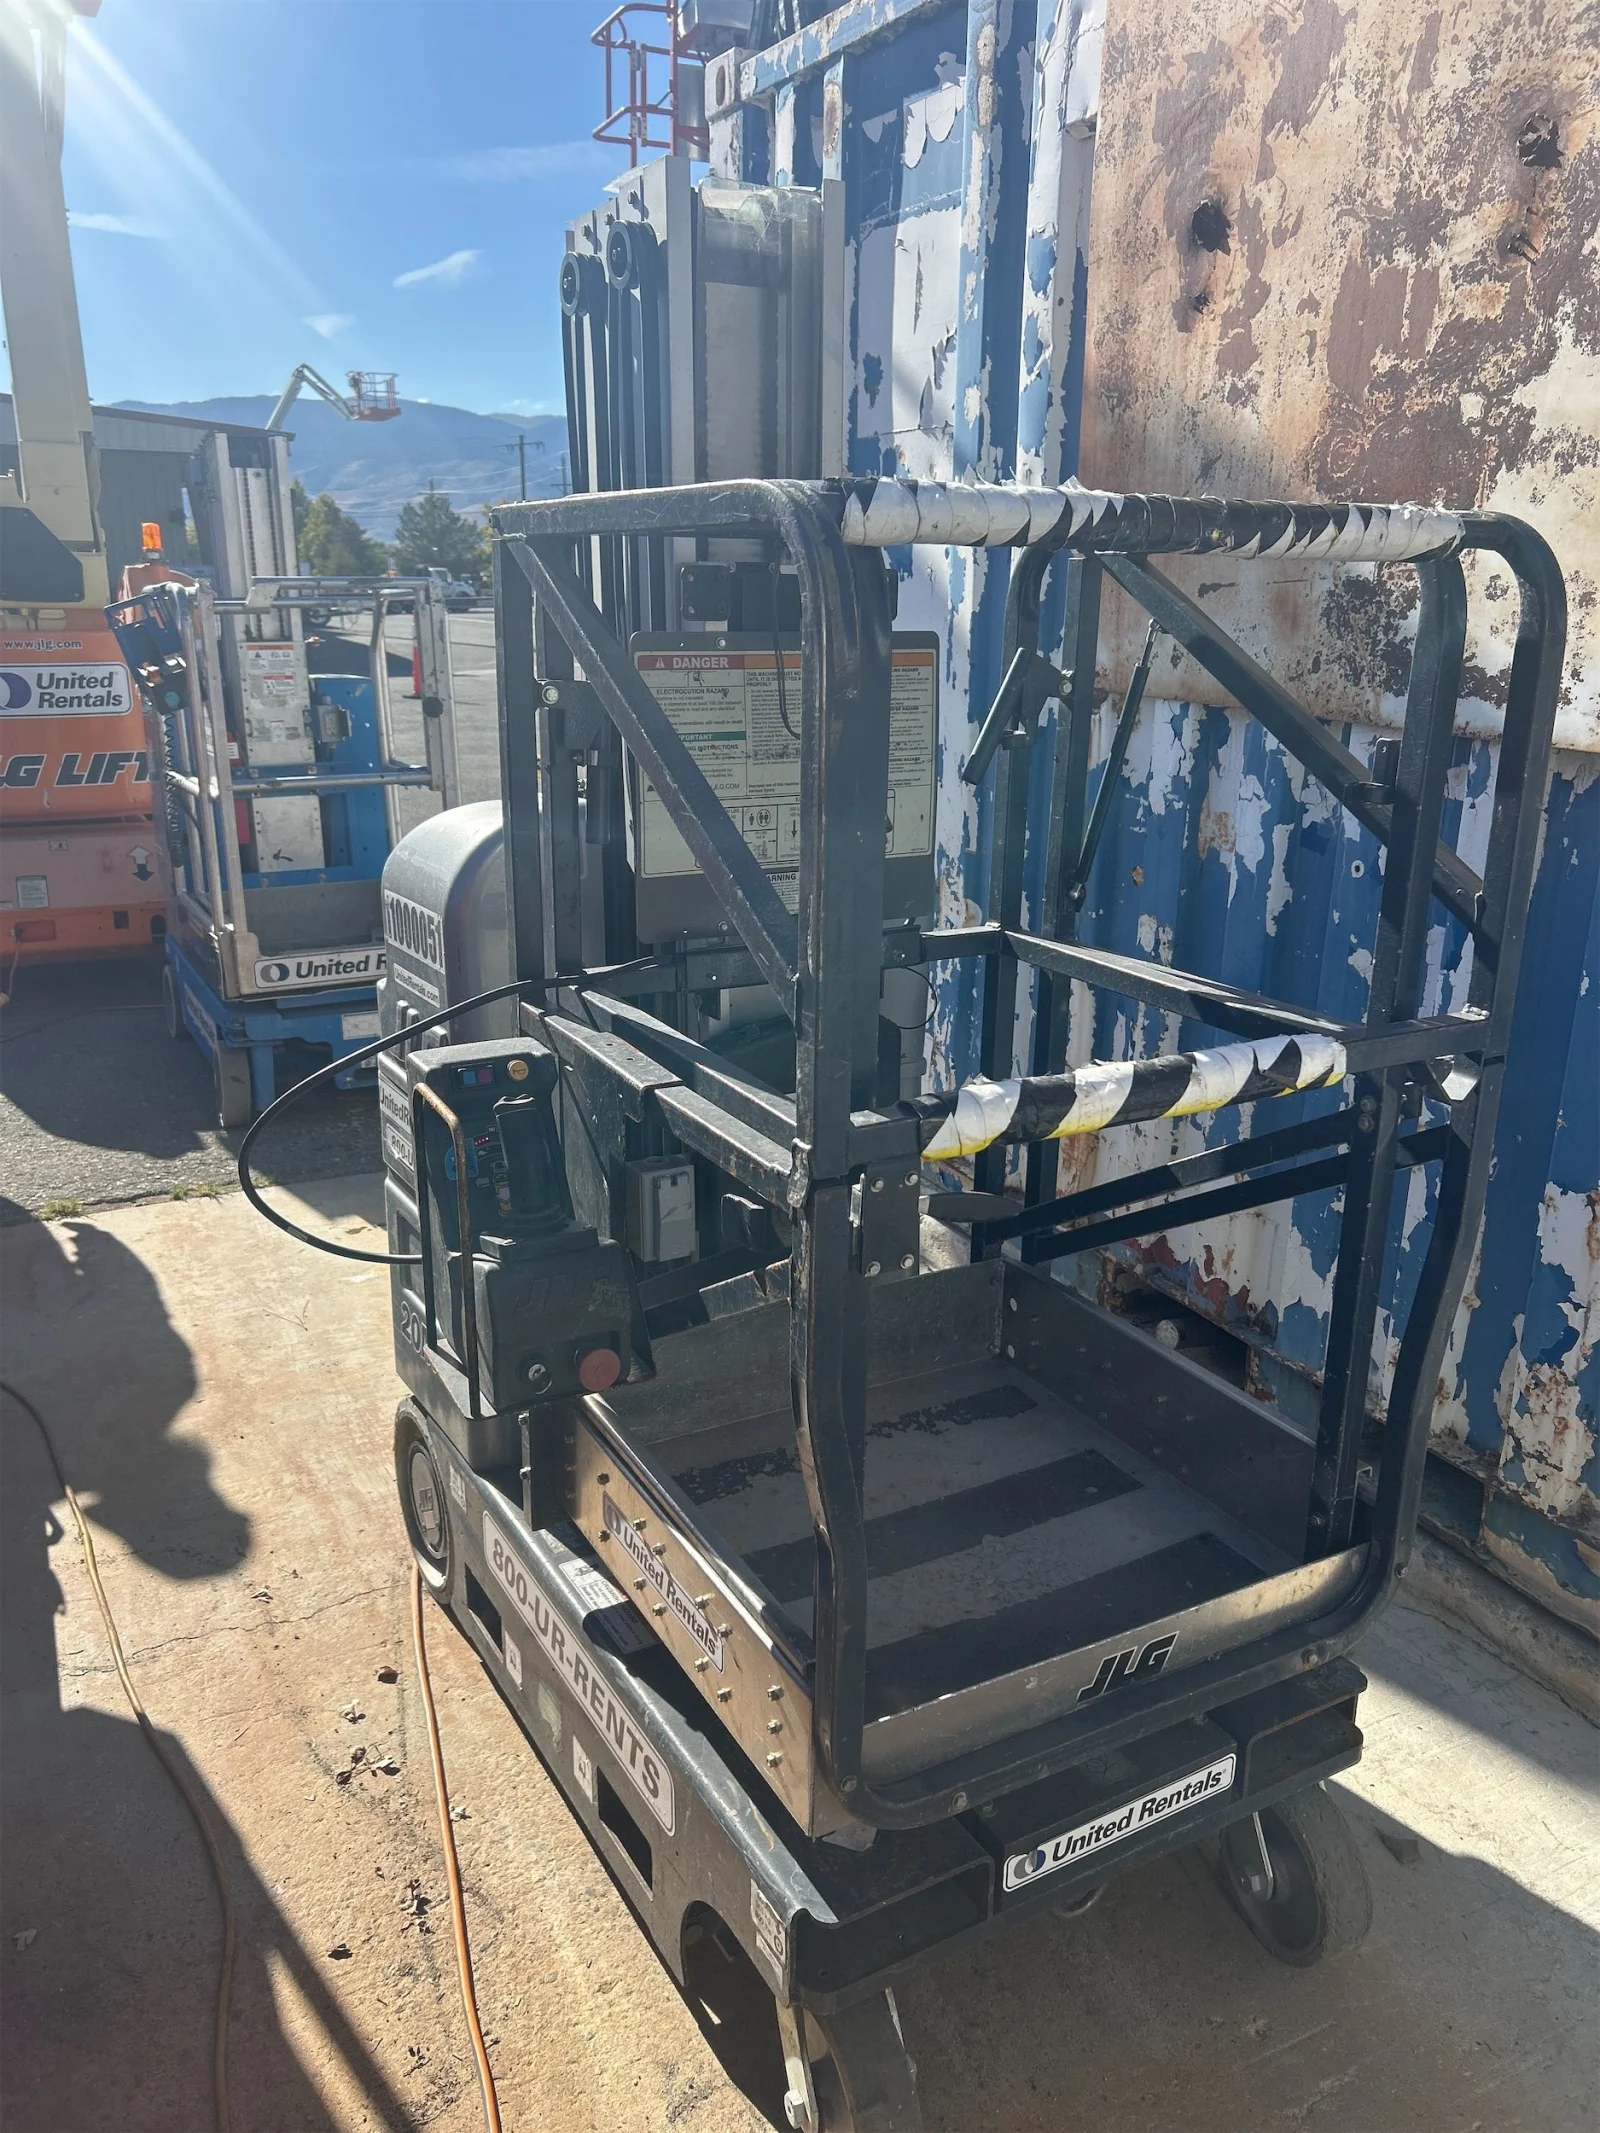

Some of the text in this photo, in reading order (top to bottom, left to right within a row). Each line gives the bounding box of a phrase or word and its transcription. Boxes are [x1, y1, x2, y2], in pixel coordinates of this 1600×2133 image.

[3, 639, 82, 651] www.jlg.com
[672, 656, 729, 669] DANGER
[36, 671, 114, 689] United
[38, 690, 123, 709] Rentals
[656, 688, 705, 696] ELECTROCUTION
[296, 955, 369, 978] United
[623, 1527, 717, 1657] United Rentals
[492, 1535, 660, 1799] 800-UR-RENTS
[1076, 1632, 1179, 1703] JLG
[1052, 1769, 1222, 1862] United Rentals
